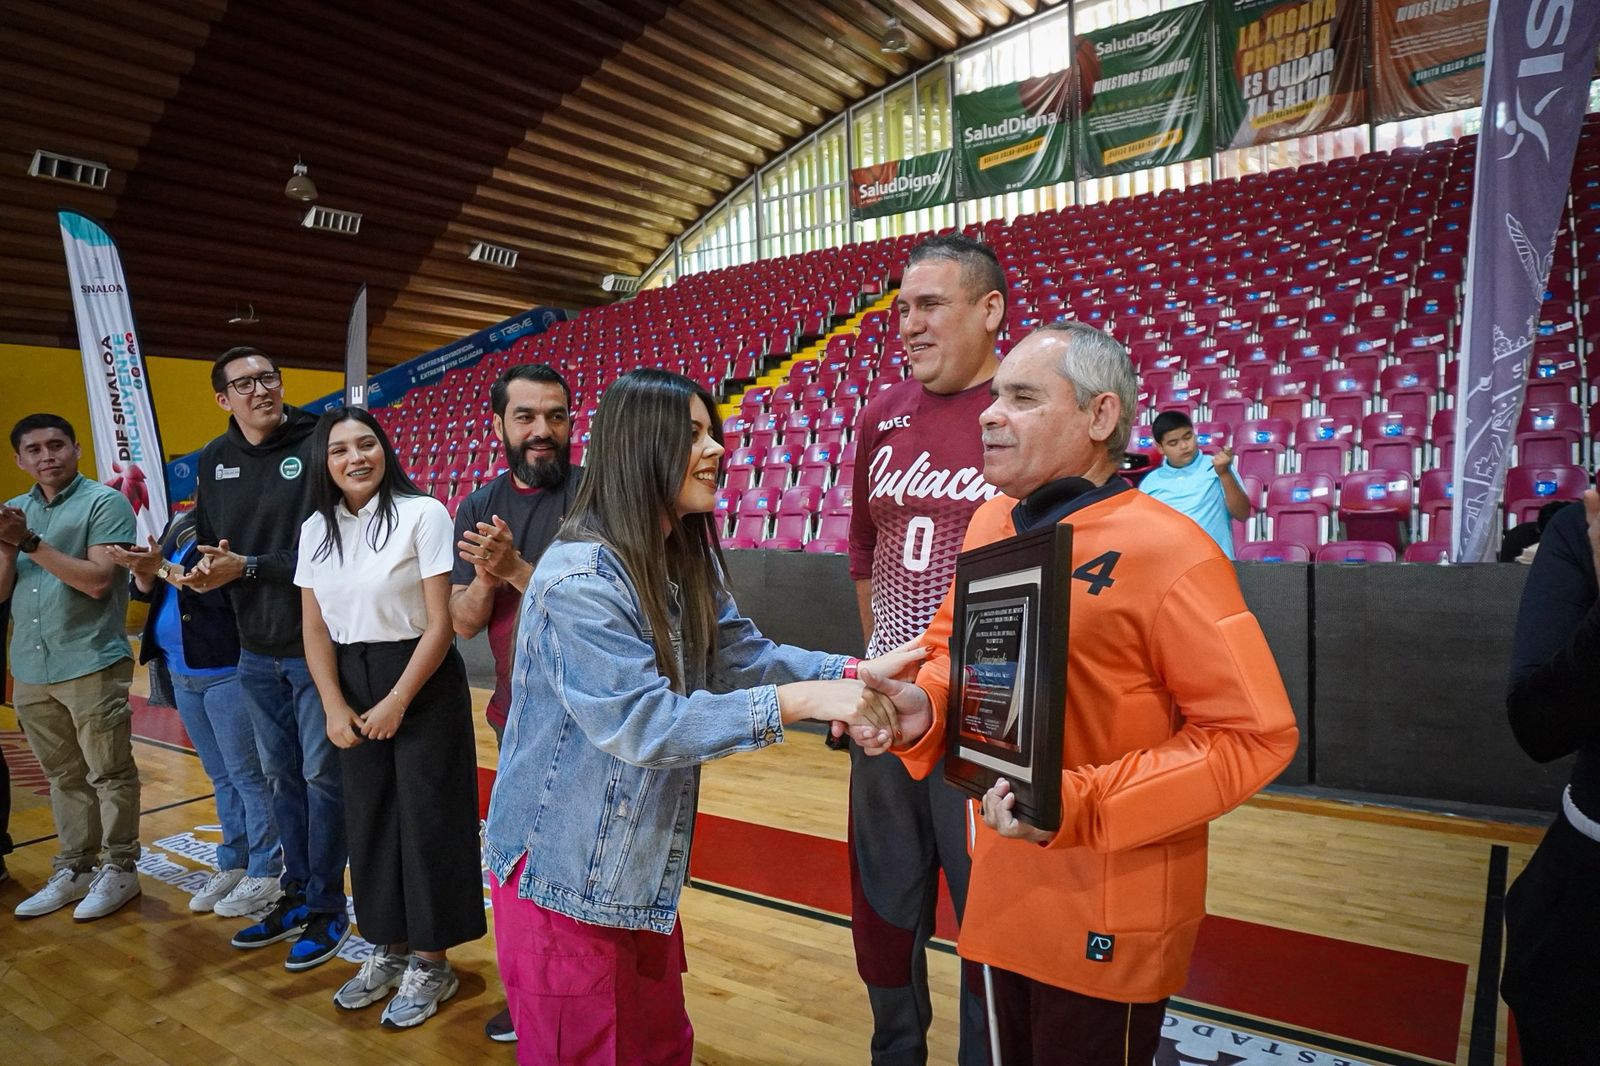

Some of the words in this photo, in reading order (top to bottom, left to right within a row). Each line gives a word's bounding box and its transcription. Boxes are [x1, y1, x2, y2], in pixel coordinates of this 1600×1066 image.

[1096, 25, 1181, 57] SaludDigna
[1243, 71, 1264, 100] ES
[1268, 48, 1335, 91] CUIDAR
[964, 112, 1057, 143] SaludDigna
[859, 172, 941, 199] SaludDigna
[101, 335, 126, 426] SINALOA
[112, 332, 143, 462] INCLUYENTE
[115, 429, 132, 462] DIF
[1072, 550, 1122, 596] 4
